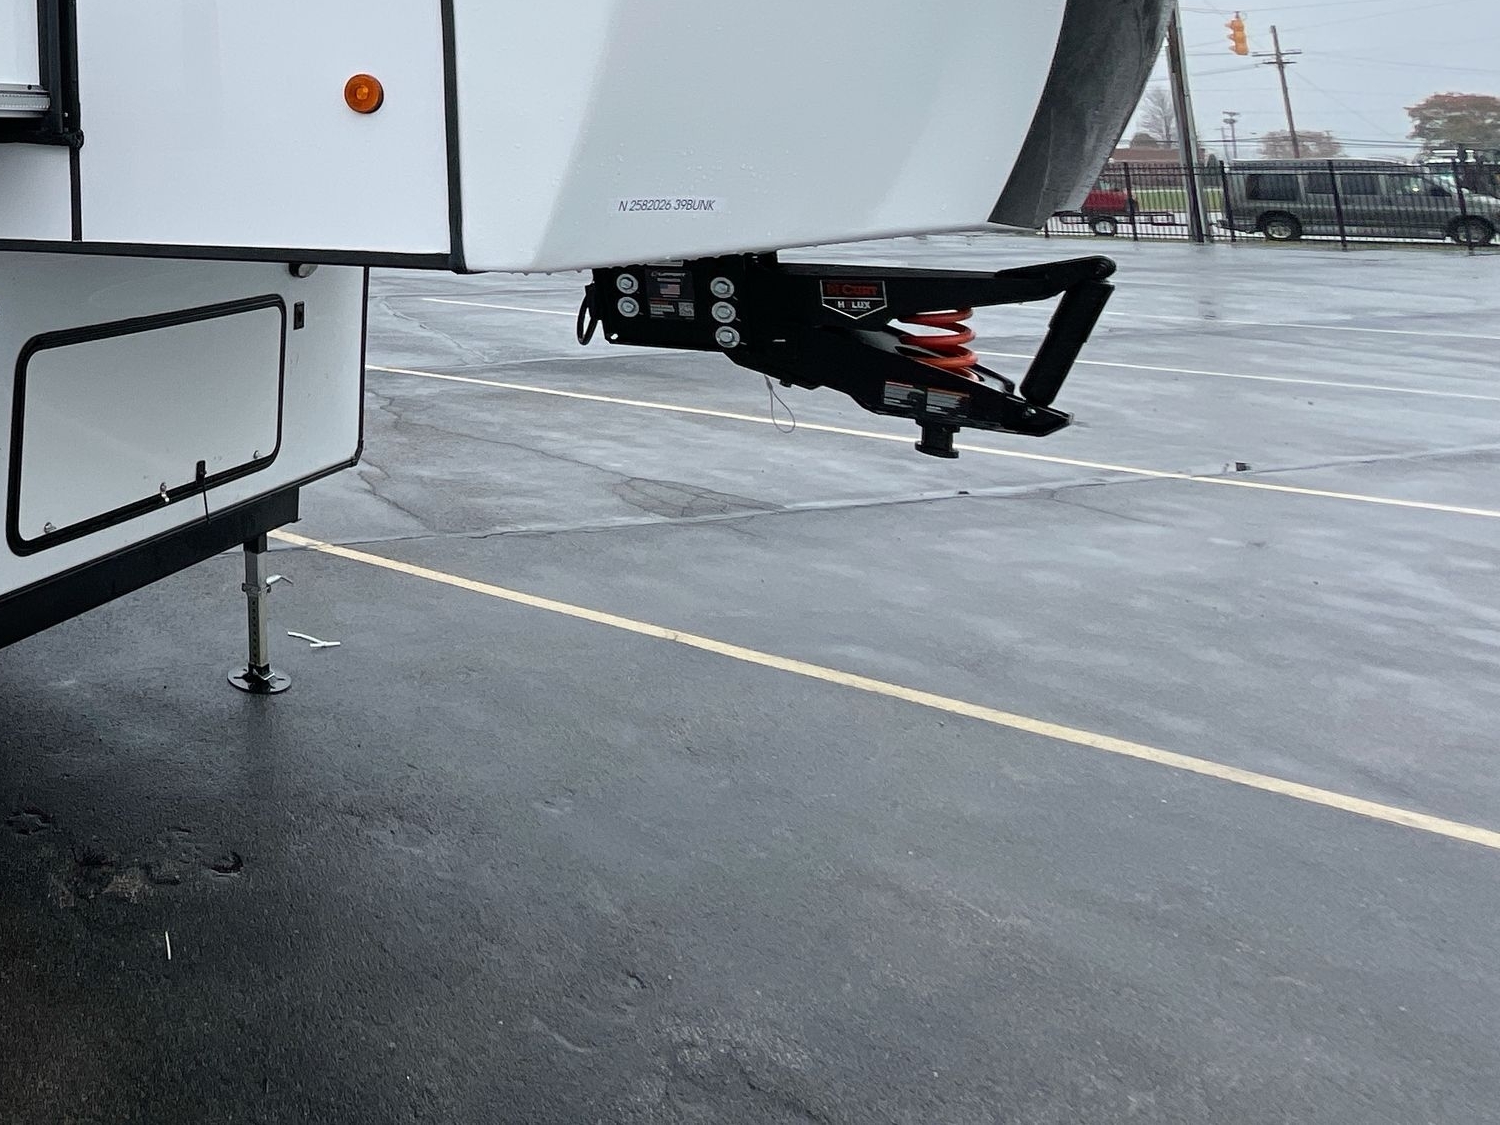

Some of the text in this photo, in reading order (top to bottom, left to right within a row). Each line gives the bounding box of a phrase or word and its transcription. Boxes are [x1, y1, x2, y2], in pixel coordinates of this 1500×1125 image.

[618, 199, 716, 212] N 2582026 39BUNK
